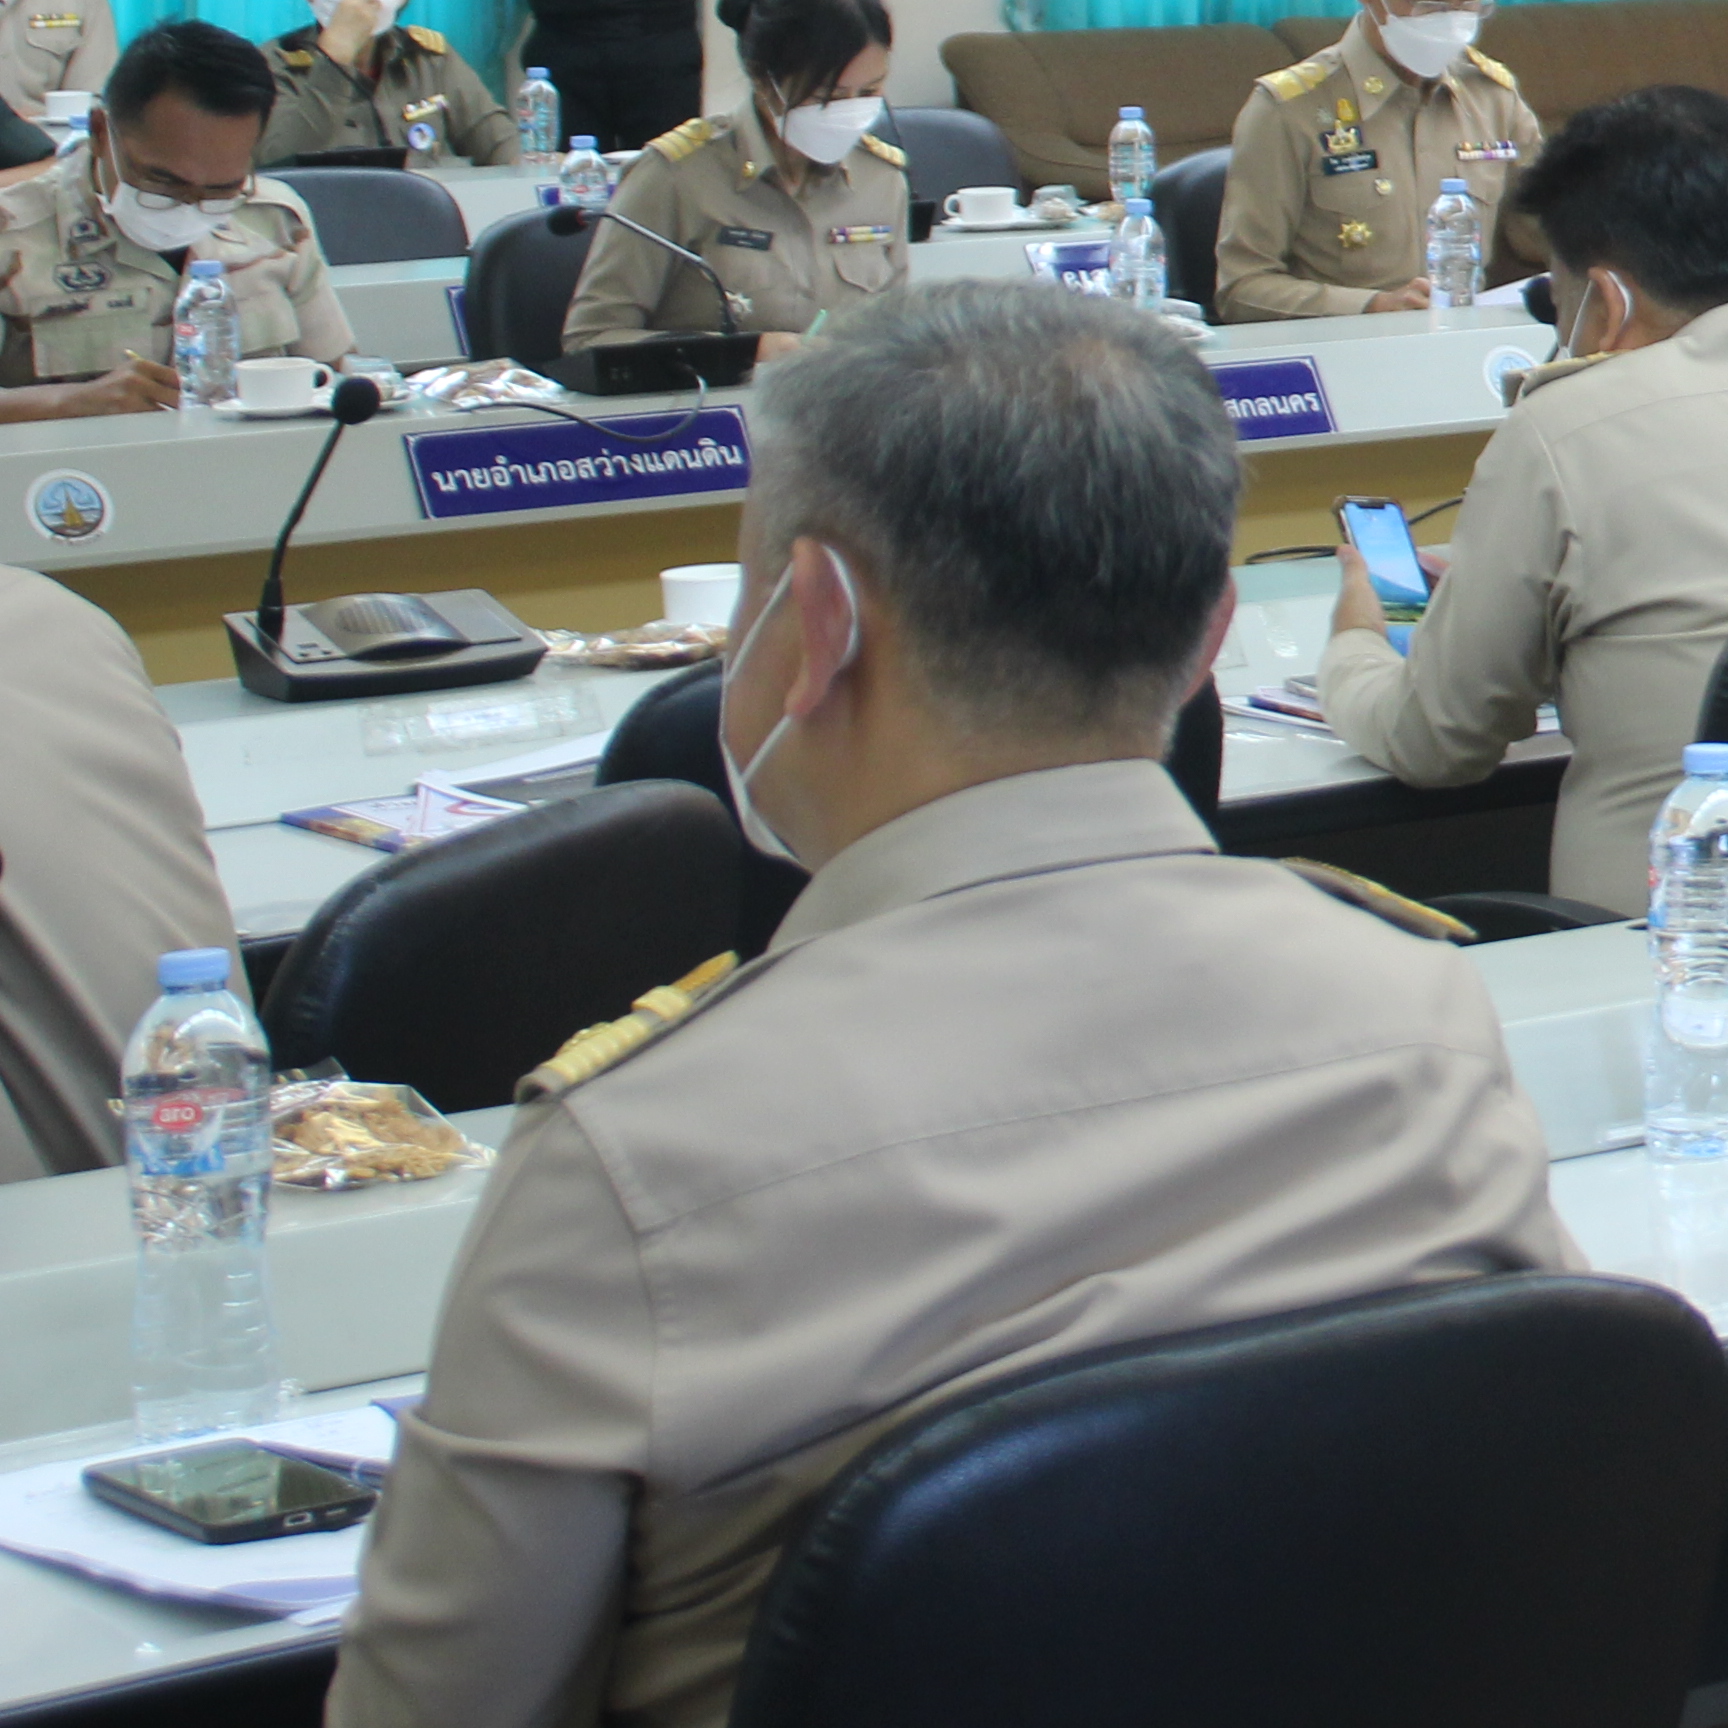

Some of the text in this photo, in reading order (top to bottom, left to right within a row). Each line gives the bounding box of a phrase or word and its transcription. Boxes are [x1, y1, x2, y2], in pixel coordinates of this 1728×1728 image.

[431, 436, 745, 493] นายอำเภอสว่างแดนดิน
